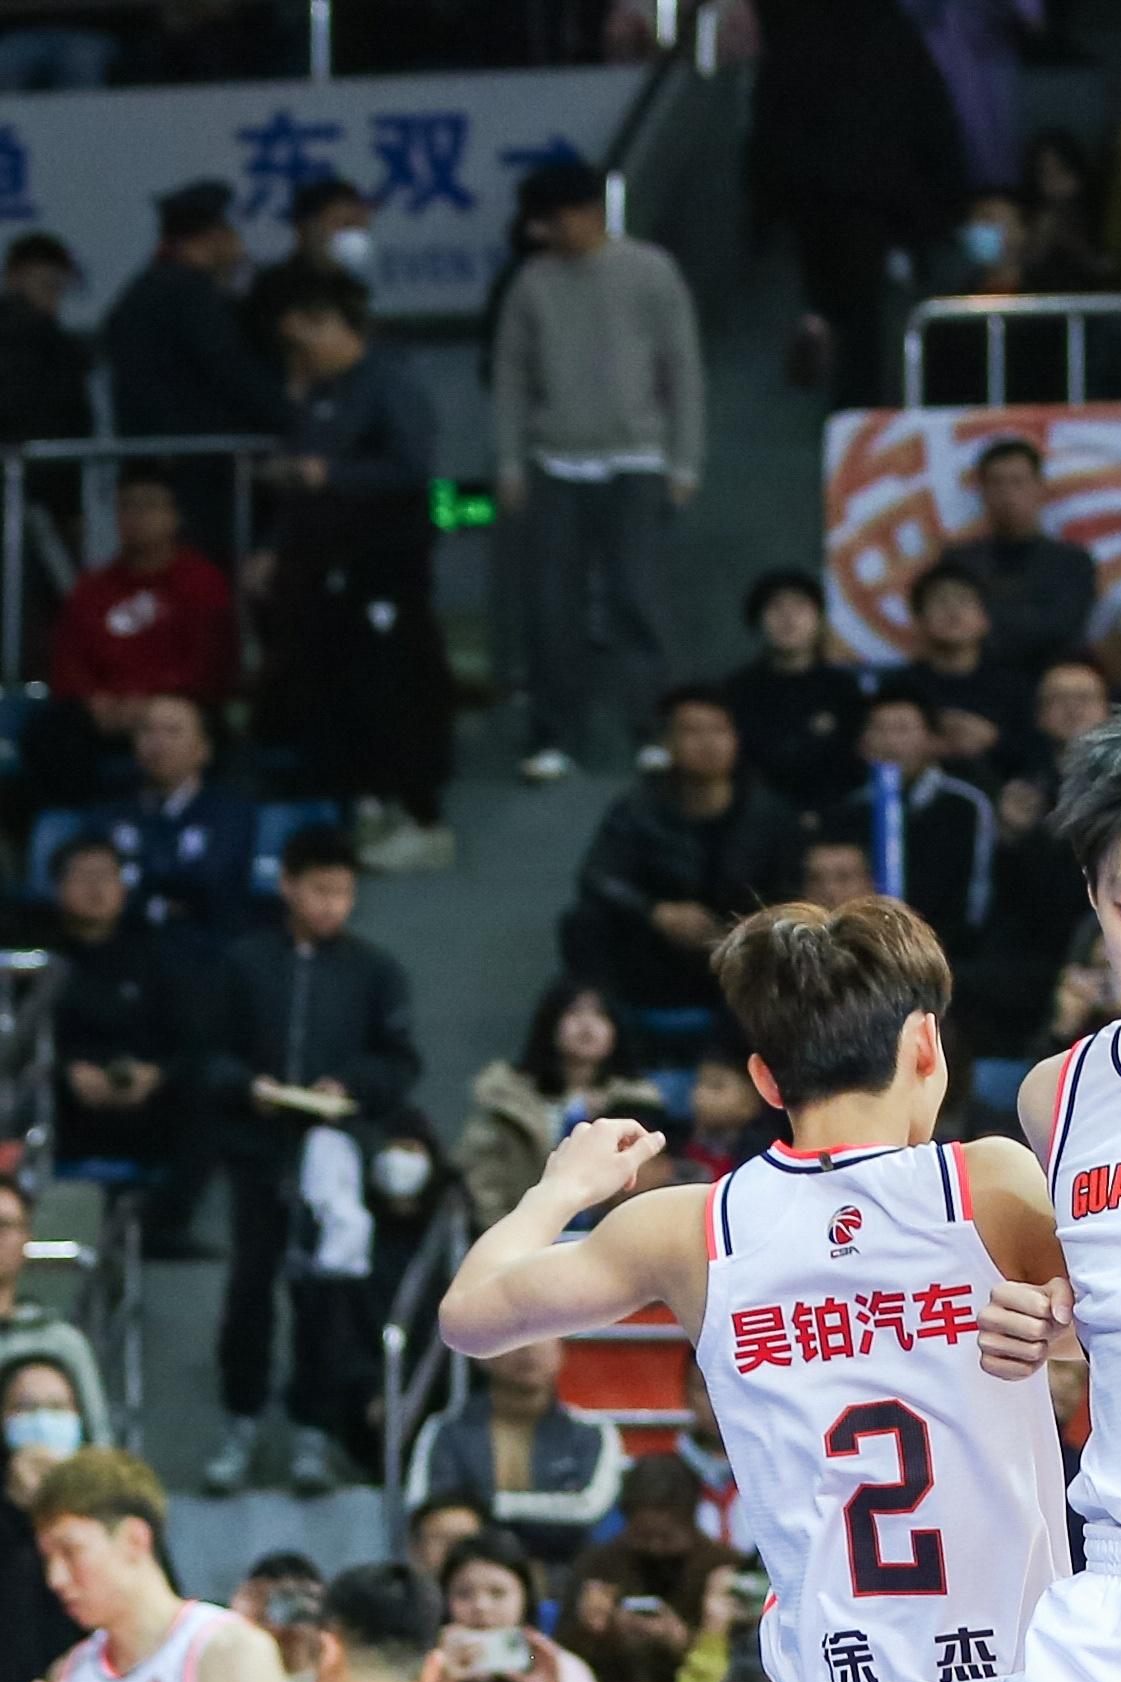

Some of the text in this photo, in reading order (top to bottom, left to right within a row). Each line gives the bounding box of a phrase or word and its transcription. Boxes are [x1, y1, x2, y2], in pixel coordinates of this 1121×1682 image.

[731, 1283, 980, 1375] 昊铂汽车
[825, 1398, 948, 1598] 2
